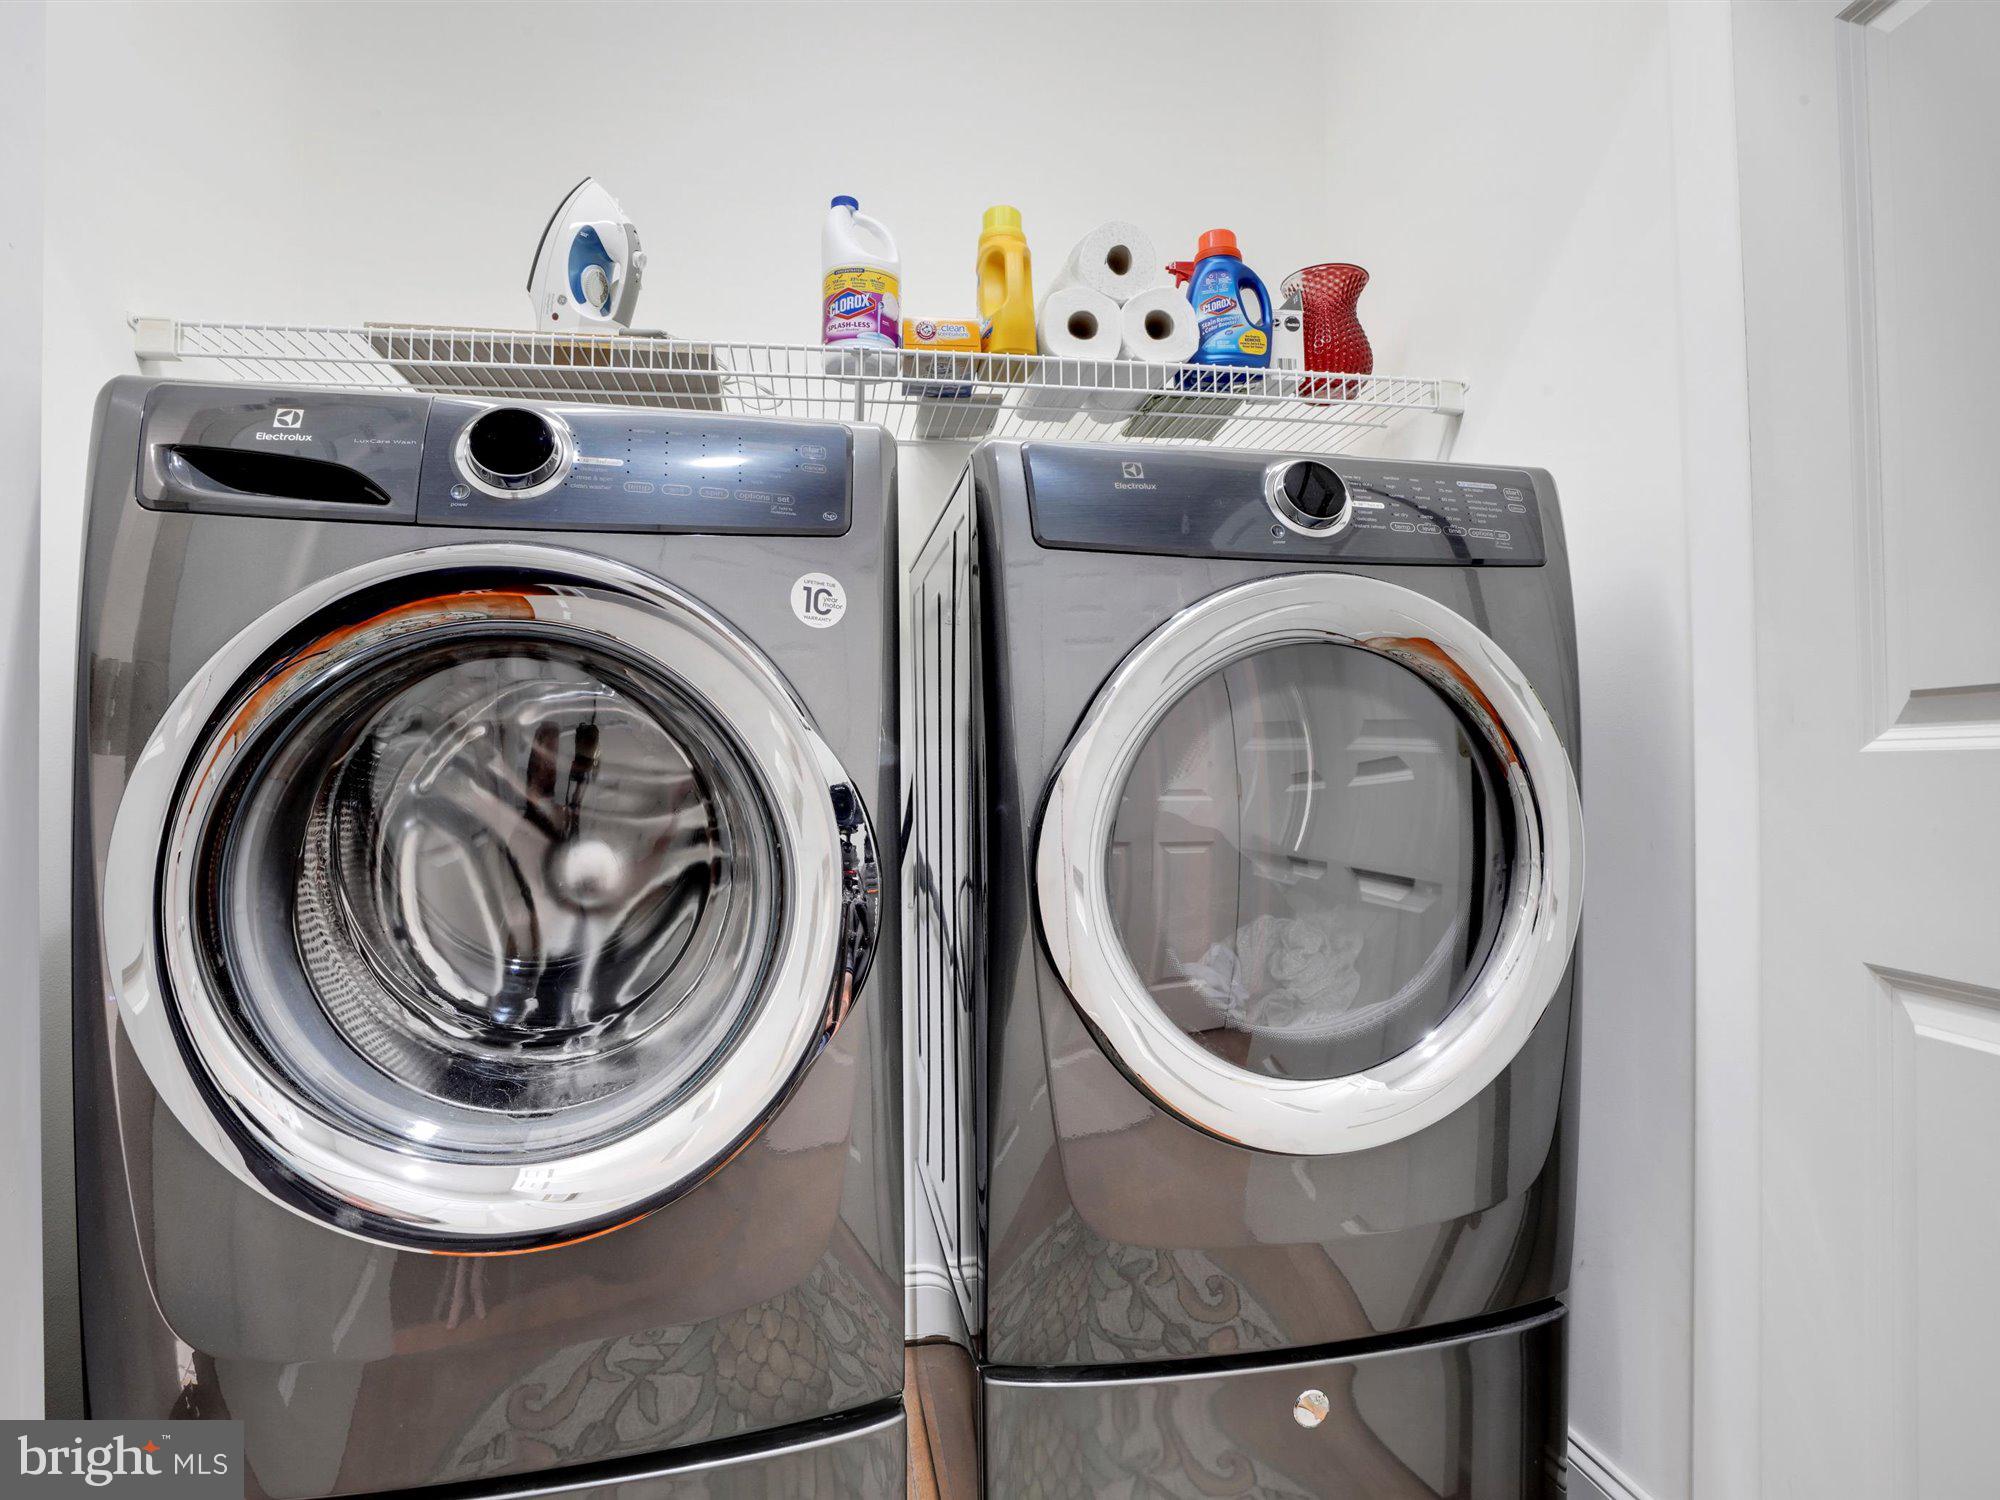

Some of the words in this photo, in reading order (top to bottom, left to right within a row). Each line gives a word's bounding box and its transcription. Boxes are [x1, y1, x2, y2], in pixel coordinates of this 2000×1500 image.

[829, 293, 872, 319] CLOROX
[1202, 298, 1232, 314] CLOROX
[828, 321, 871, 332] SPLASH-LESS
[1201, 319, 1216, 329] Stain
[256, 432, 312, 442] Electrolux
[1114, 482, 1157, 490] Electrolux
[739, 492, 770, 501] options
[1394, 523, 1410, 531] temp
[1471, 530, 1494, 538] options
[803, 579, 826, 587] LIFETIME
